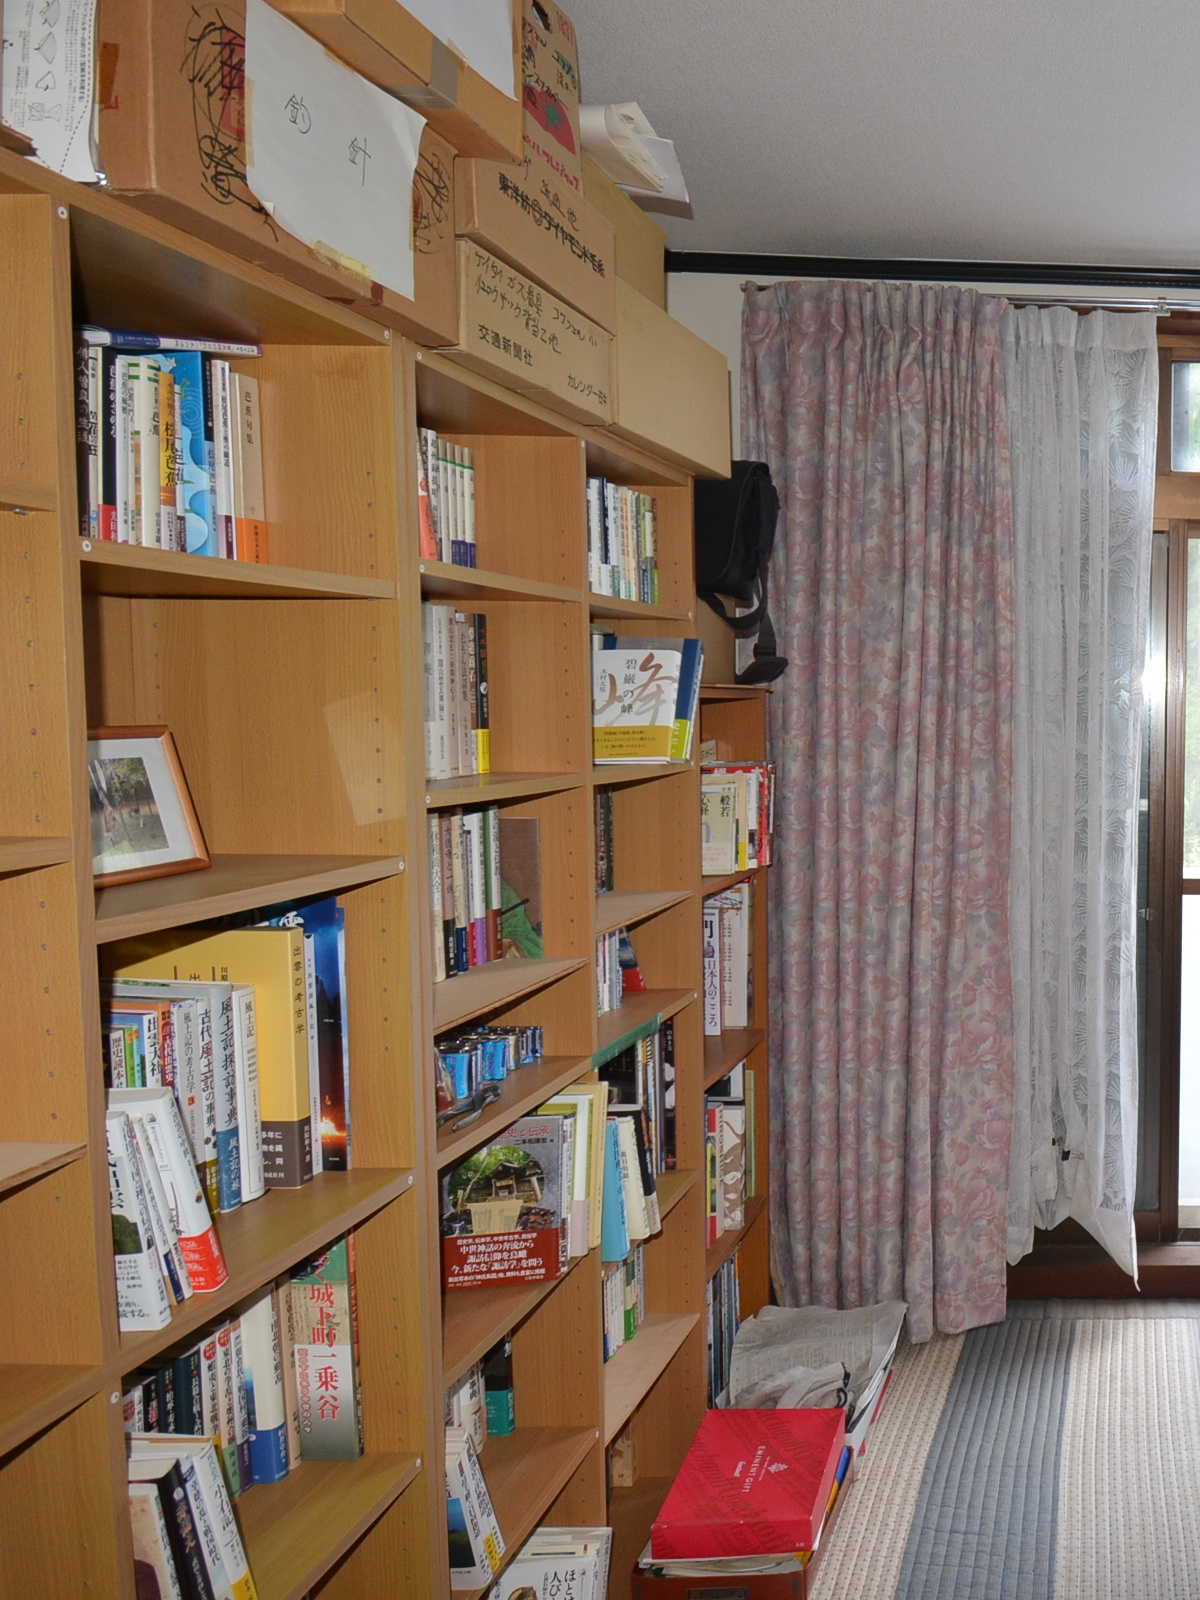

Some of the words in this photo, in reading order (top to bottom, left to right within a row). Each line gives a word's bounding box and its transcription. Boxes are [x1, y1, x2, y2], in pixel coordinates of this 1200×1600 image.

[478, 323, 533, 367] 交通新聞社
[244, 391, 253, 446] 芭蕉句集
[163, 421, 175, 487] 松尾芭蕉
[208, 449, 216, 496] 松尾芭蕉
[620, 658, 638, 714] 碧巌の峰
[720, 795, 731, 818] 般若
[444, 827, 454, 894] 大徳寺と一休
[293, 946, 305, 1035] 出雲の考古学
[707, 960, 718, 1028] 日本人のこころ
[244, 1001, 255, 1038] 風土記
[112, 1037, 124, 1081] 歴史読本
[184, 1012, 196, 1094] 風土記の考古学
[199, 1008, 217, 1127] 古代風土記の事典
[219, 997, 238, 1126] 風土記探訪事典
[741, 1476, 754, 1493] GIFT
[748, 1445, 766, 1477] EMINENT
[214, 1483, 234, 1531] 小右記
[549, 1571, 562, 1600] 人び
